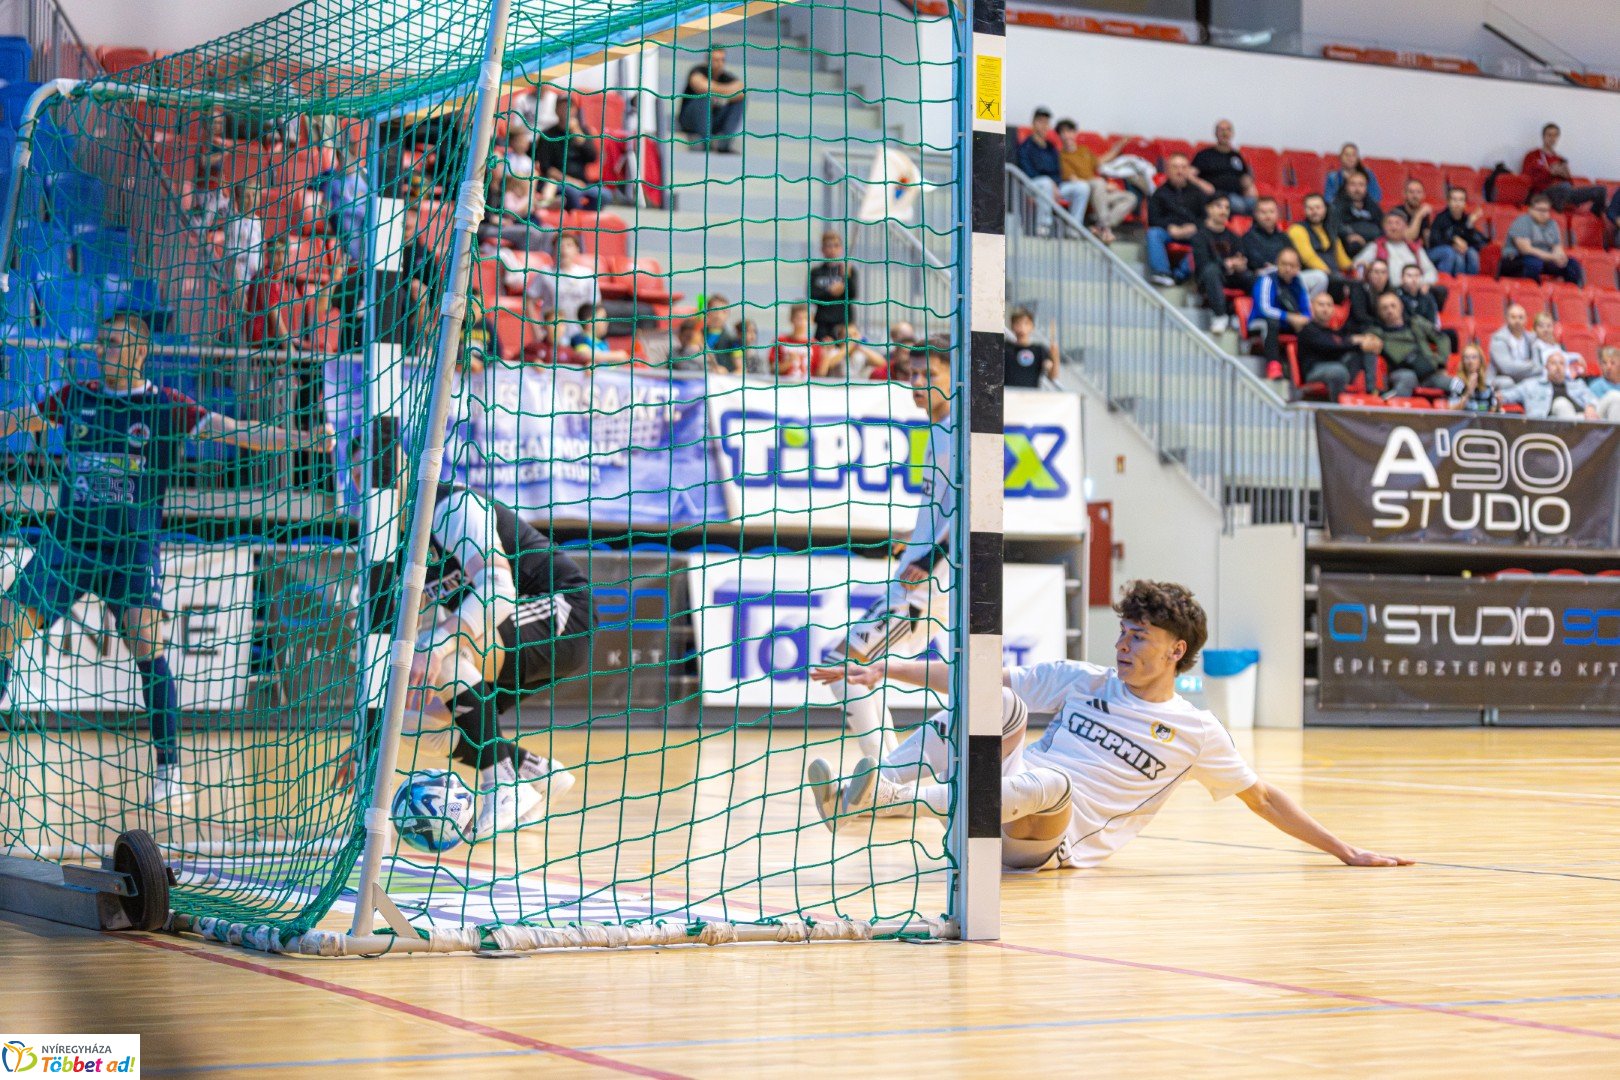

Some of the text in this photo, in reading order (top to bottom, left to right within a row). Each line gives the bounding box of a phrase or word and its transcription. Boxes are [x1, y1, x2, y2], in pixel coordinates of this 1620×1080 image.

[1372, 490, 1571, 534] STUDIO
[607, 647, 662, 666] KFT
[1578, 661, 1618, 677] KFT
